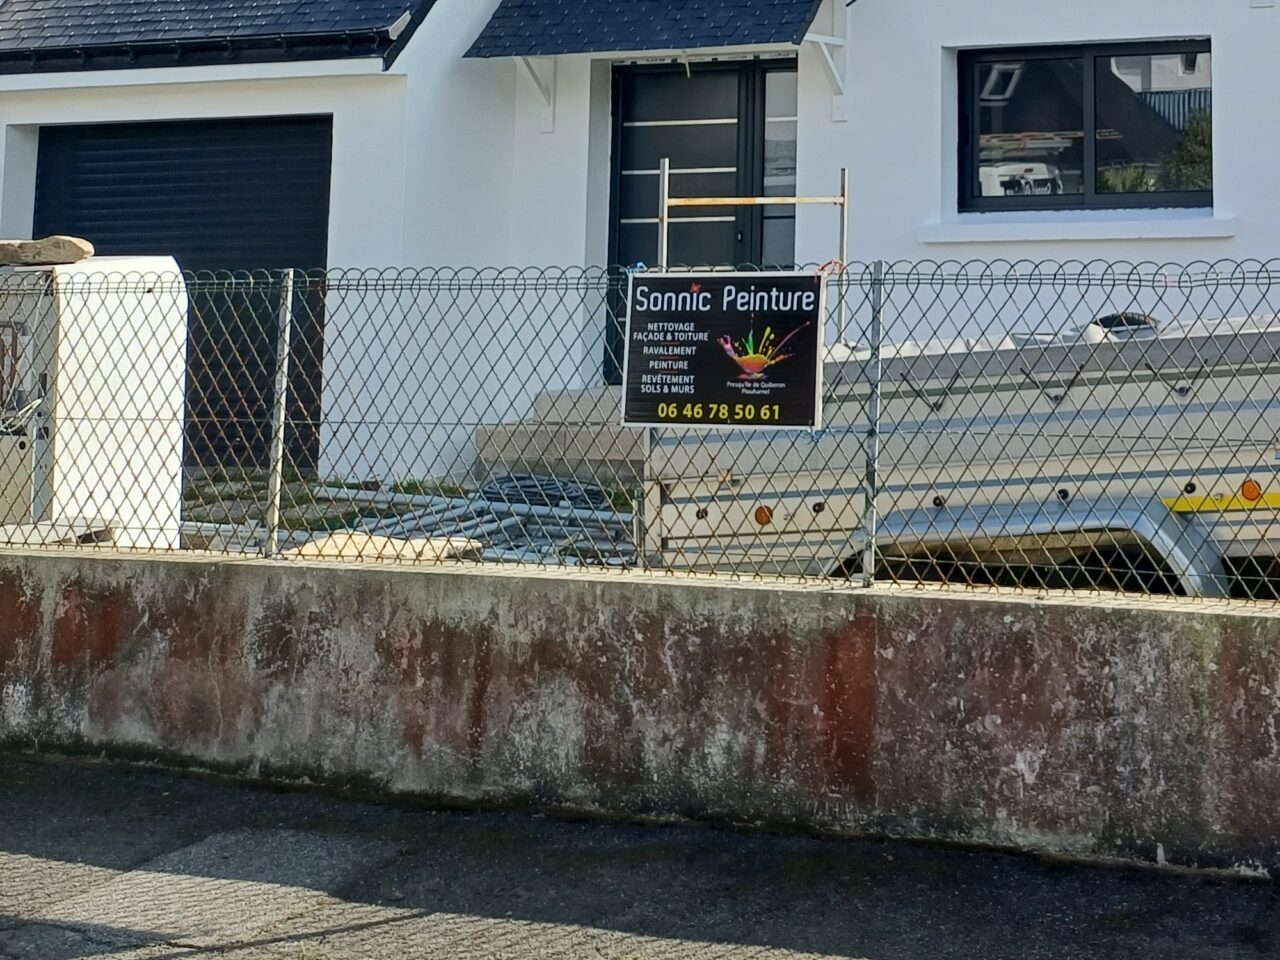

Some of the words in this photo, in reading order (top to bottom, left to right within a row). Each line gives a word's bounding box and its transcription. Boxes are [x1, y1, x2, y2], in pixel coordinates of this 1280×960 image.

[636, 282, 711, 311] Sonnic
[722, 285, 815, 311] Peinture
[647, 322, 694, 331] NETTOYAGE
[633, 332, 664, 342] FAÇADE
[666, 332, 672, 340] &
[674, 332, 708, 341] TOITURE
[643, 346, 696, 355] RAVALEMENT
[649, 360, 688, 369] PEINTURE
[641, 374, 694, 383] REVÊTEMENT
[641, 385, 661, 393] SOLS
[663, 385, 669, 393] &
[671, 385, 694, 393] MURS
[658, 402, 678, 418] 06
[682, 403, 703, 418] 46
[708, 404, 728, 419] 78
[734, 404, 755, 419] 50
[760, 405, 779, 420] 61
